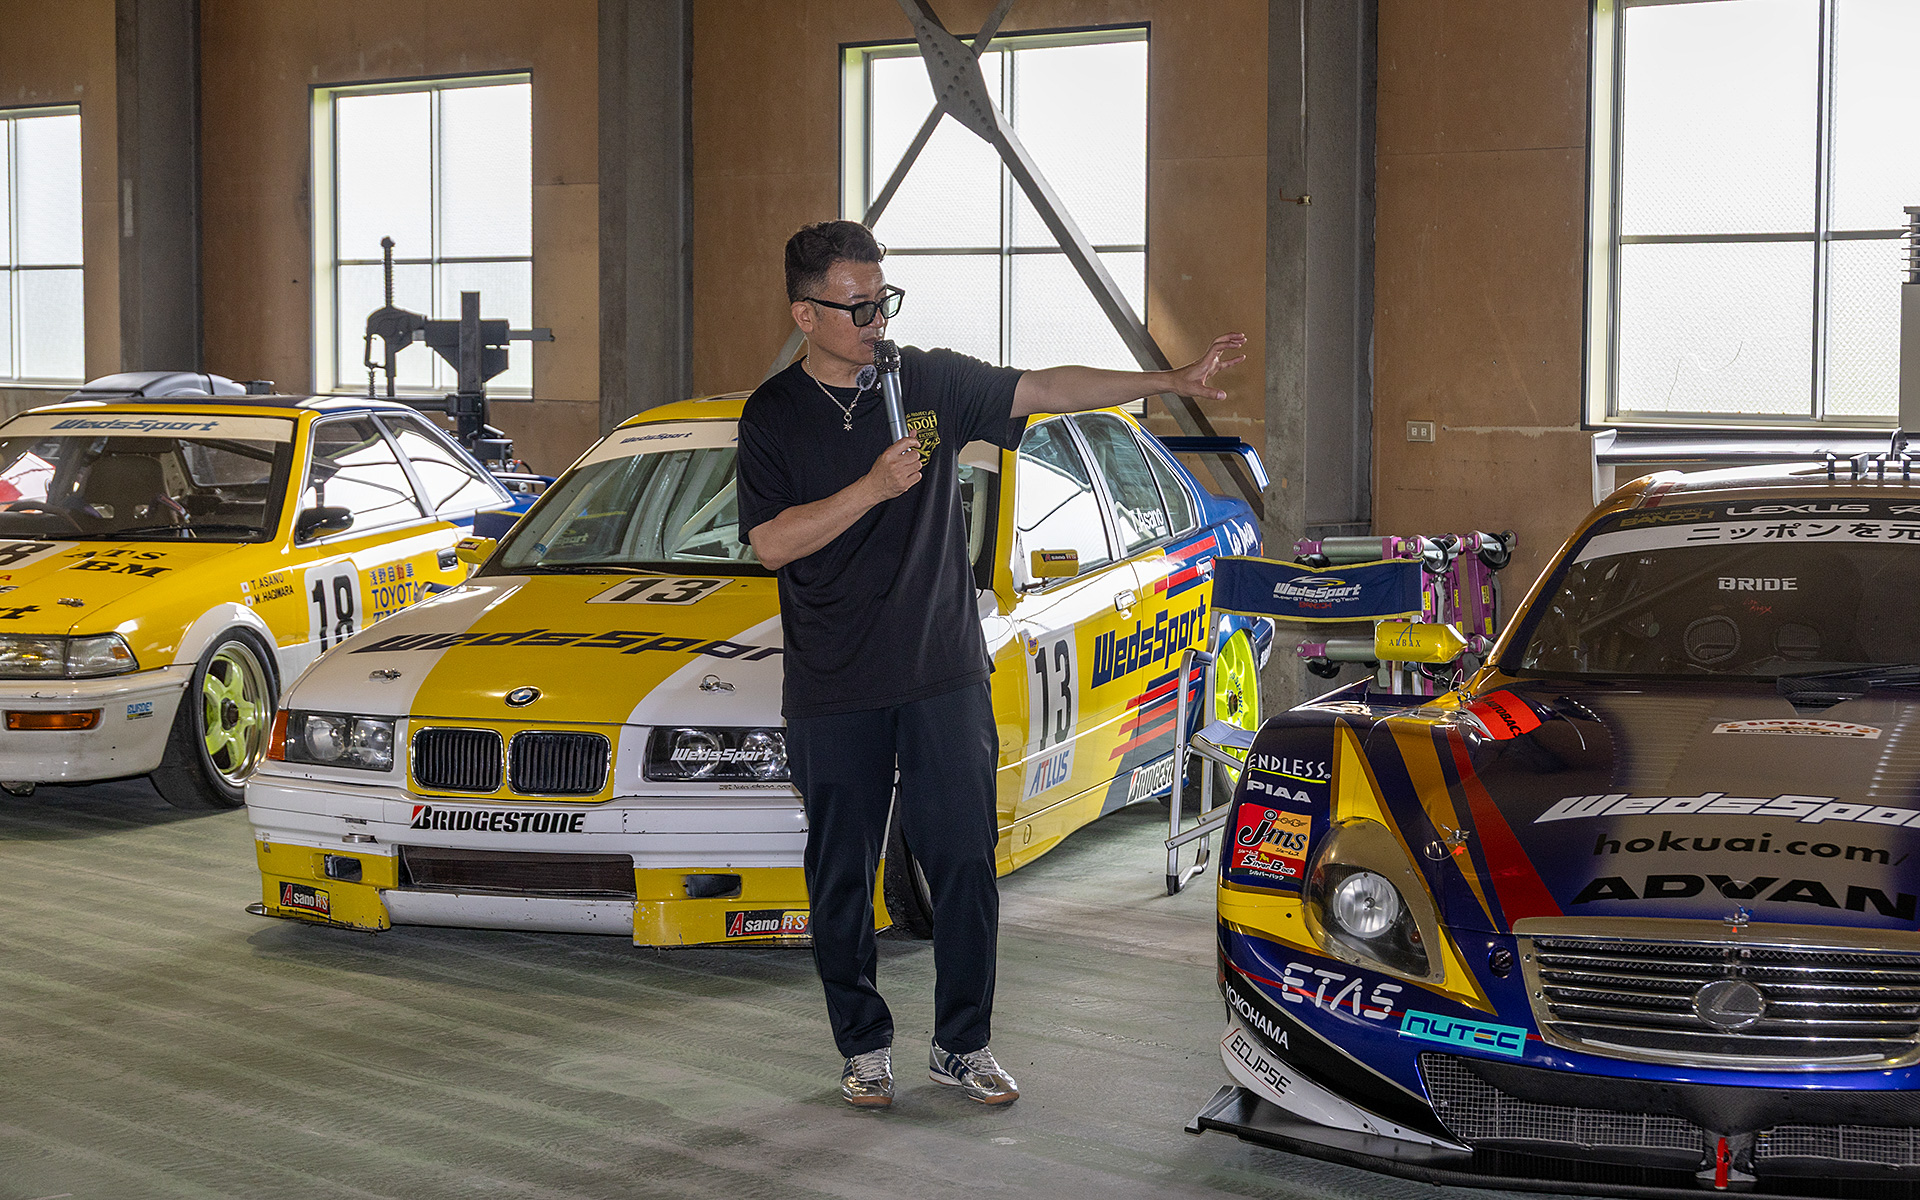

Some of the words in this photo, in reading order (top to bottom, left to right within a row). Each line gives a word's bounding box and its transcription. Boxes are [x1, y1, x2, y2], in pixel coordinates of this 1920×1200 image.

[51, 418, 219, 432] WedsSport
[906, 415, 937, 430] NDOH
[1620, 510, 1715, 527] BANDOH
[1726, 504, 1870, 516] LEXUS
[371, 580, 420, 609] TOYOTA
[609, 578, 721, 602] 13
[1273, 582, 1362, 600] WedsSport
[1718, 577, 1798, 591] BRIDE
[347, 629, 784, 661] WedsSpor
[1091, 594, 1207, 690] WedsSport
[1034, 639, 1072, 752] 13
[670, 748, 773, 763] WedsSport
[1248, 753, 1326, 779] ENDLESS
[1029, 750, 1070, 797] ATLUS
[1247, 780, 1312, 803] PIAA
[410, 805, 587, 833] BRIDGESTONE
[1570, 874, 1918, 921] ADVAN
[1282, 962, 1403, 1020] ETAS
[1225, 980, 1290, 1050] YOKOHAMA
[1230, 1035, 1292, 1095] ECLIPSE
